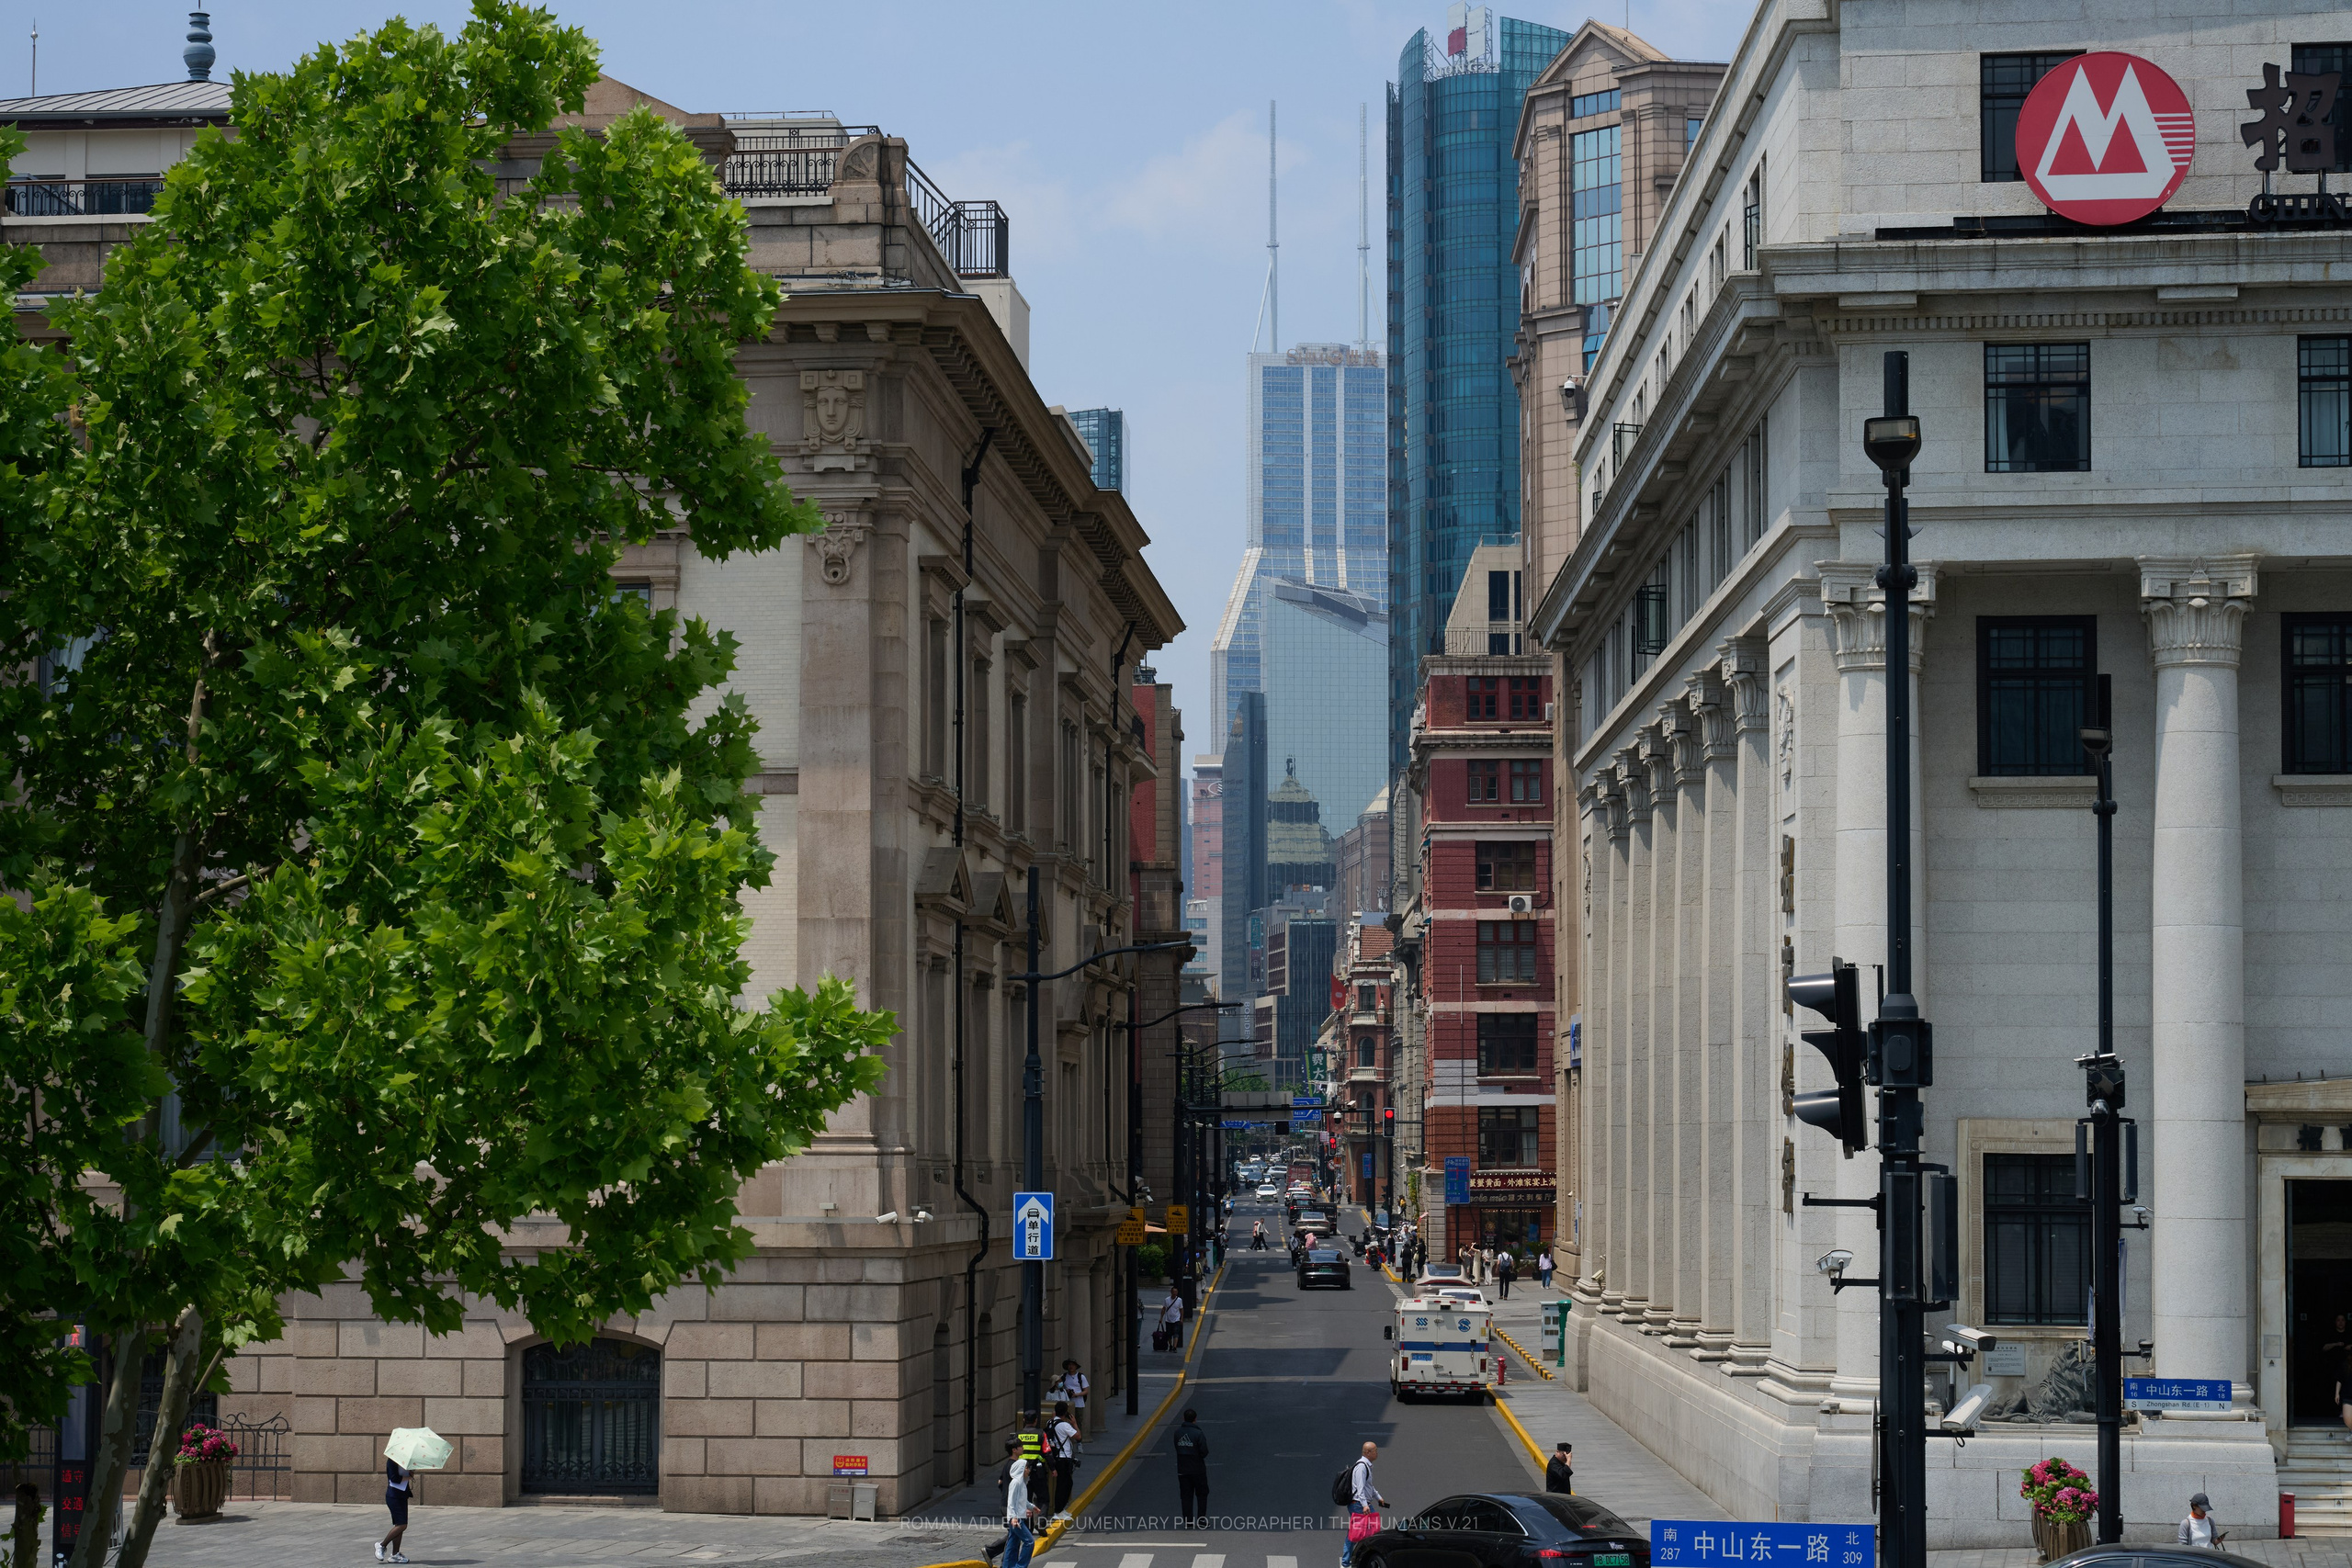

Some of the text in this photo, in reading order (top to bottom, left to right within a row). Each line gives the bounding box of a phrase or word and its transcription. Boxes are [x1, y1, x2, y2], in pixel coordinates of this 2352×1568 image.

[2240, 62, 2343, 172] 招
[2249, 192, 2352, 222] CHIN
[1027, 1220, 1039, 1256] 单行道
[2130, 1382, 2226, 1397] 南 中山东一路 北
[62, 1470, 84, 1483] 遵守
[62, 1496, 84, 1511] 交通
[61, 1523, 81, 1538] 信号
[1664, 1528, 1860, 1562] 南 中山东一路 北
[1660, 1547, 1863, 1565] 287 309
